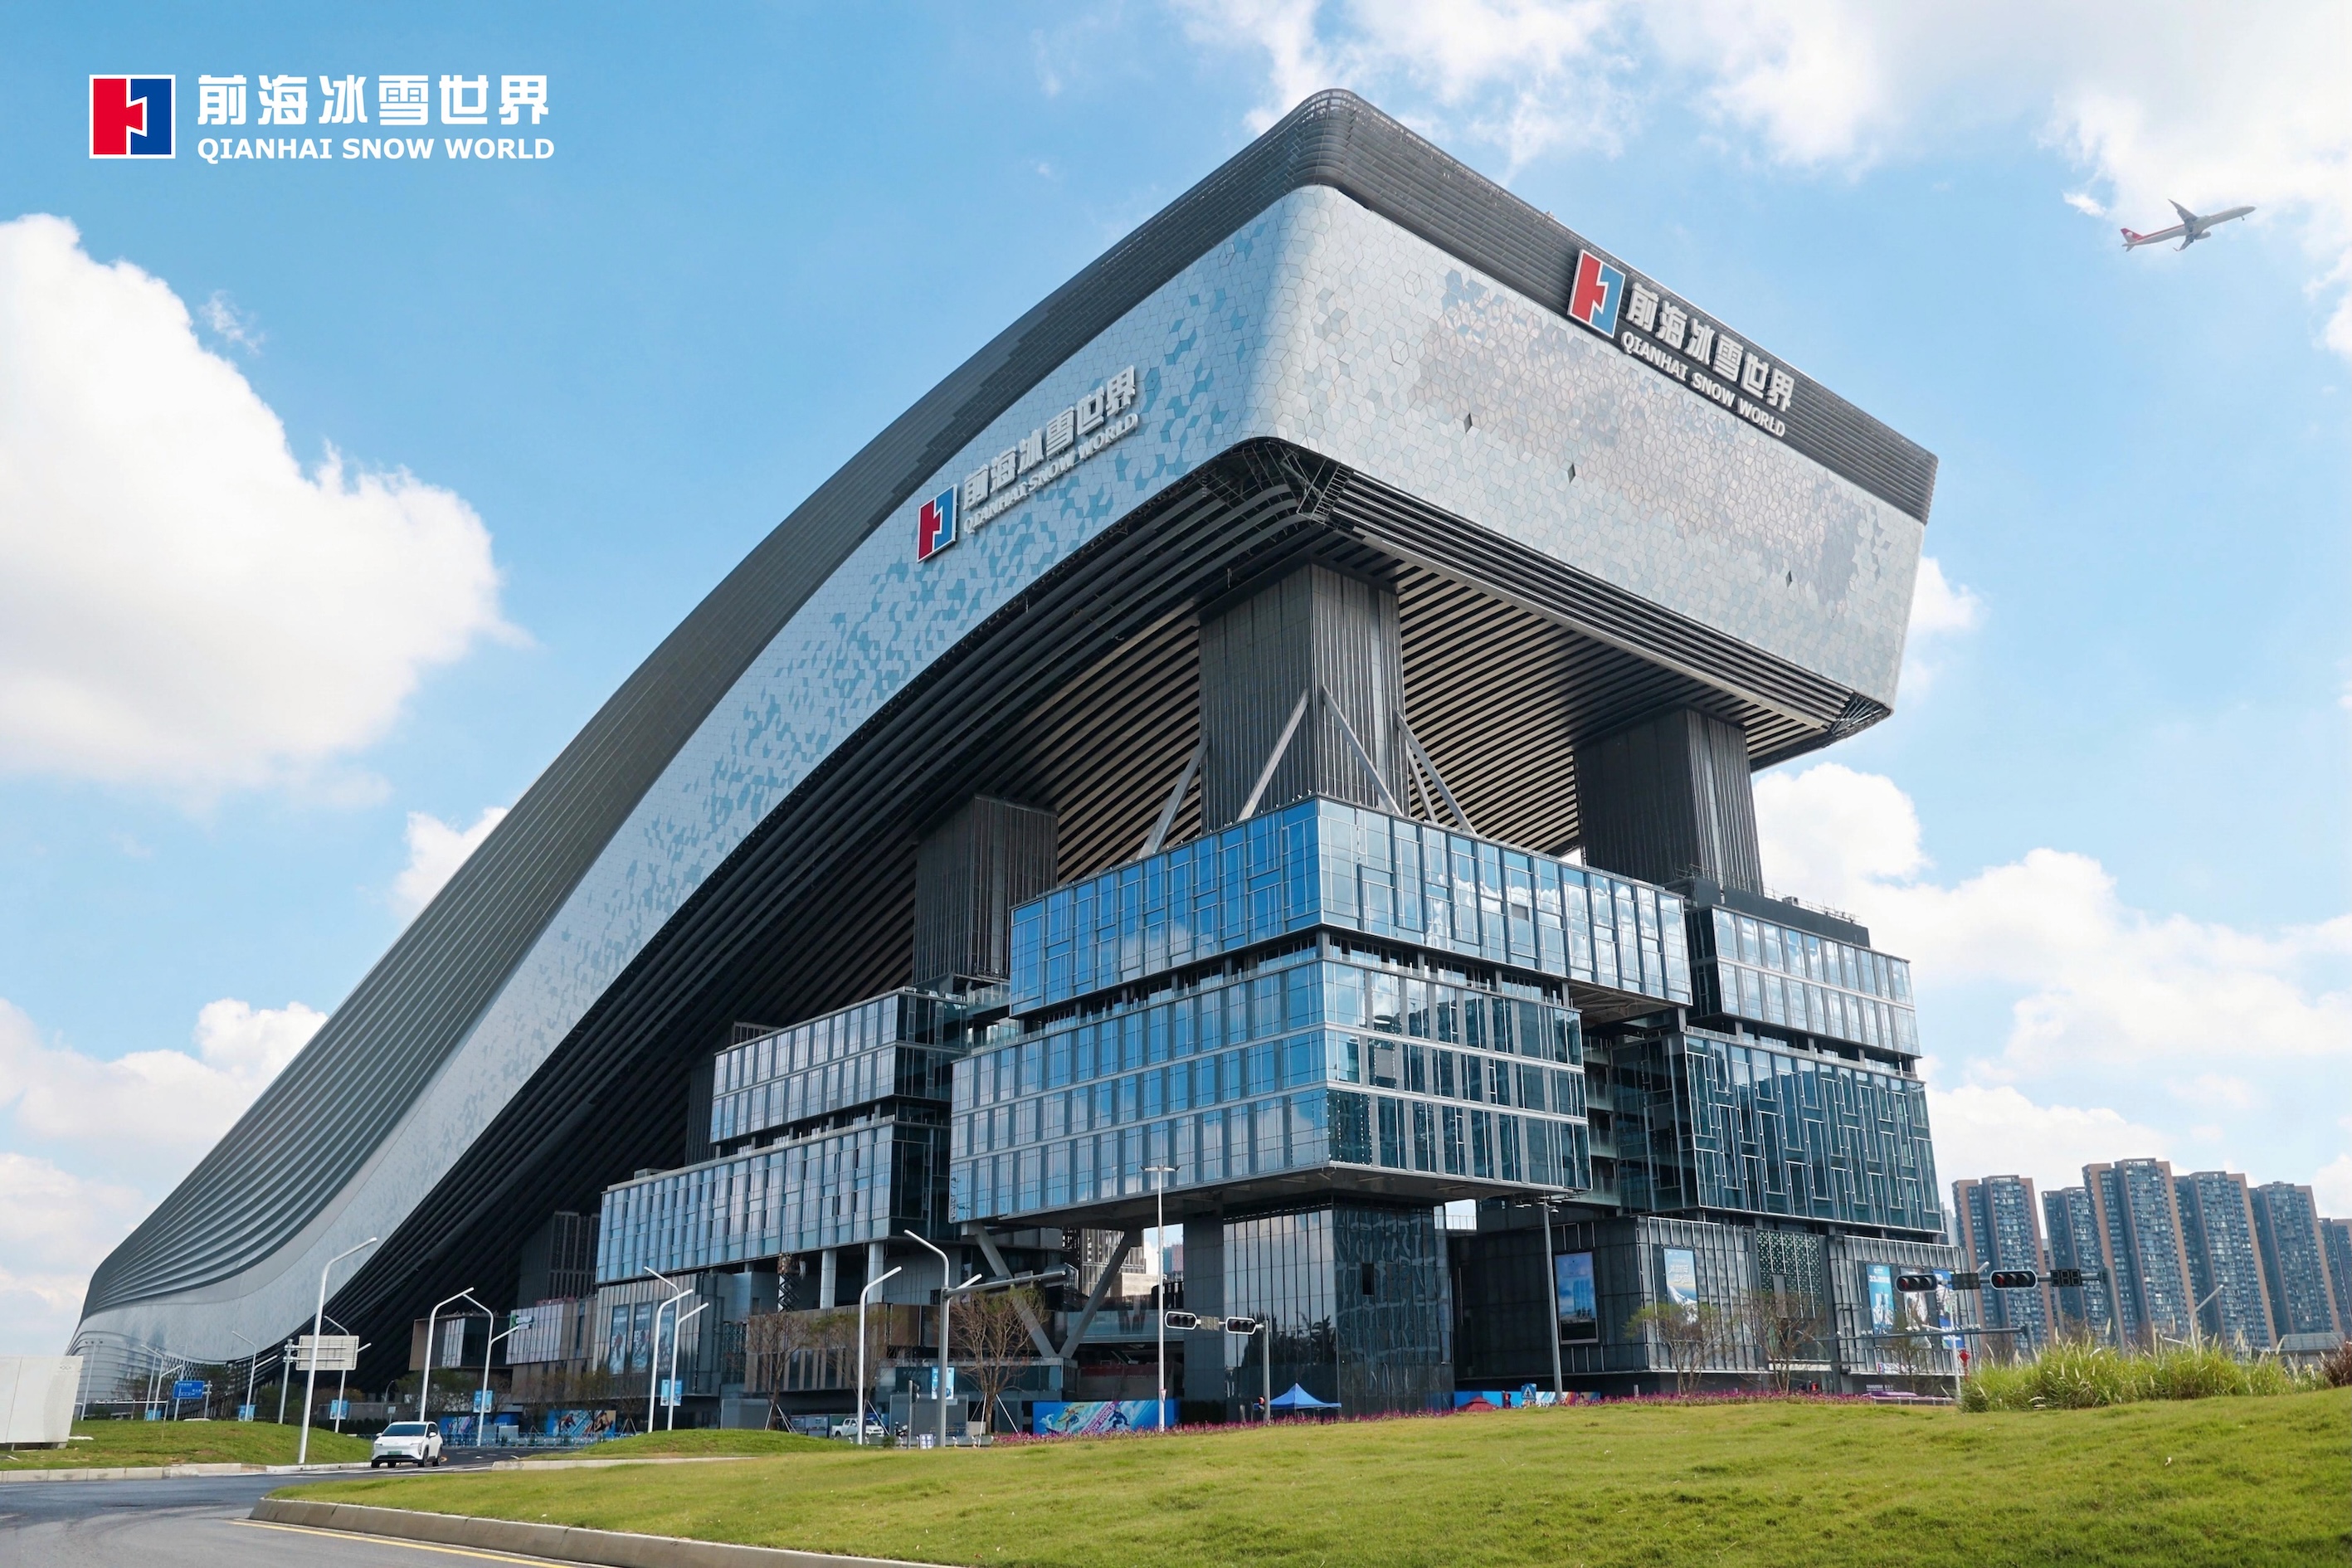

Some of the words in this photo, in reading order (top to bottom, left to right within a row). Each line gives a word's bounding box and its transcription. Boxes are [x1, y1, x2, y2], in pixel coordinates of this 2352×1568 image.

[1621, 331, 1688, 382] QIANHAI
[1692, 372, 1736, 407] SNOW
[1738, 397, 1786, 437] WORLD
[1625, 282, 1794, 411] 前海冰雪世界
[962, 365, 1136, 511] 前海冰雪世界
[963, 482, 1029, 534] QIANHAI
[1028, 449, 1076, 491] SNOW
[1078, 413, 1139, 460] WORLD
